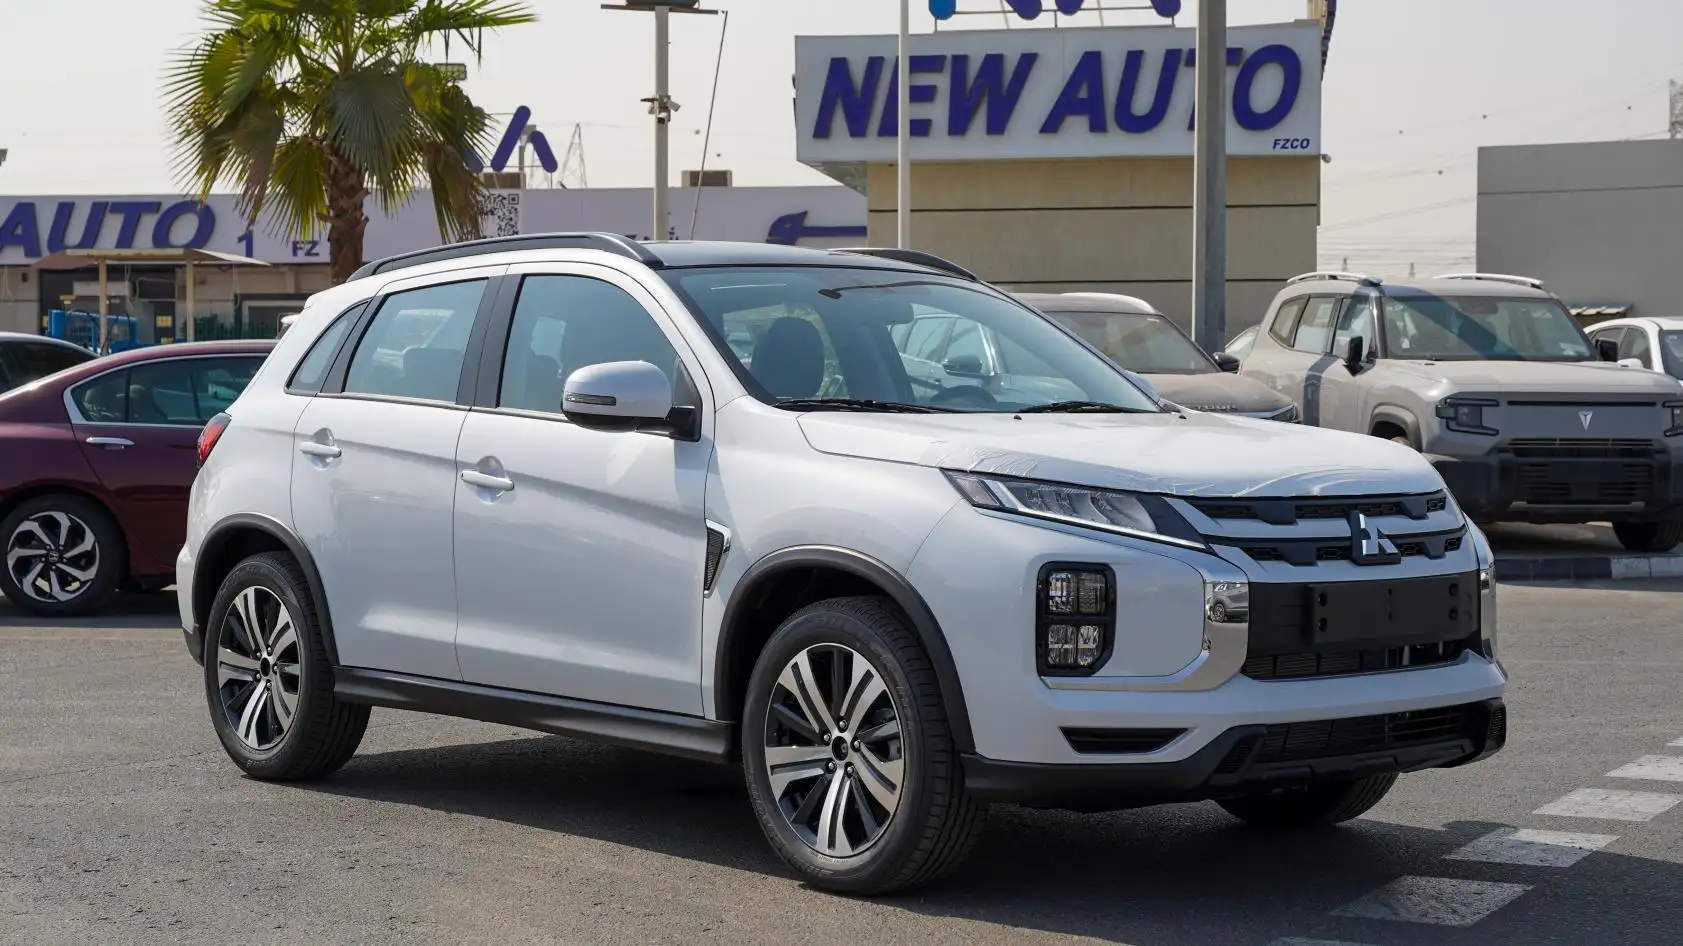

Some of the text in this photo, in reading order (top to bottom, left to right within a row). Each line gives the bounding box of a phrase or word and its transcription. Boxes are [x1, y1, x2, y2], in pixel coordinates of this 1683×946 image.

[813, 52, 1038, 139] NEW
[1272, 138, 1311, 150] FZCO
[0, 200, 216, 259] AUTO
[237, 230, 254, 259] 1
